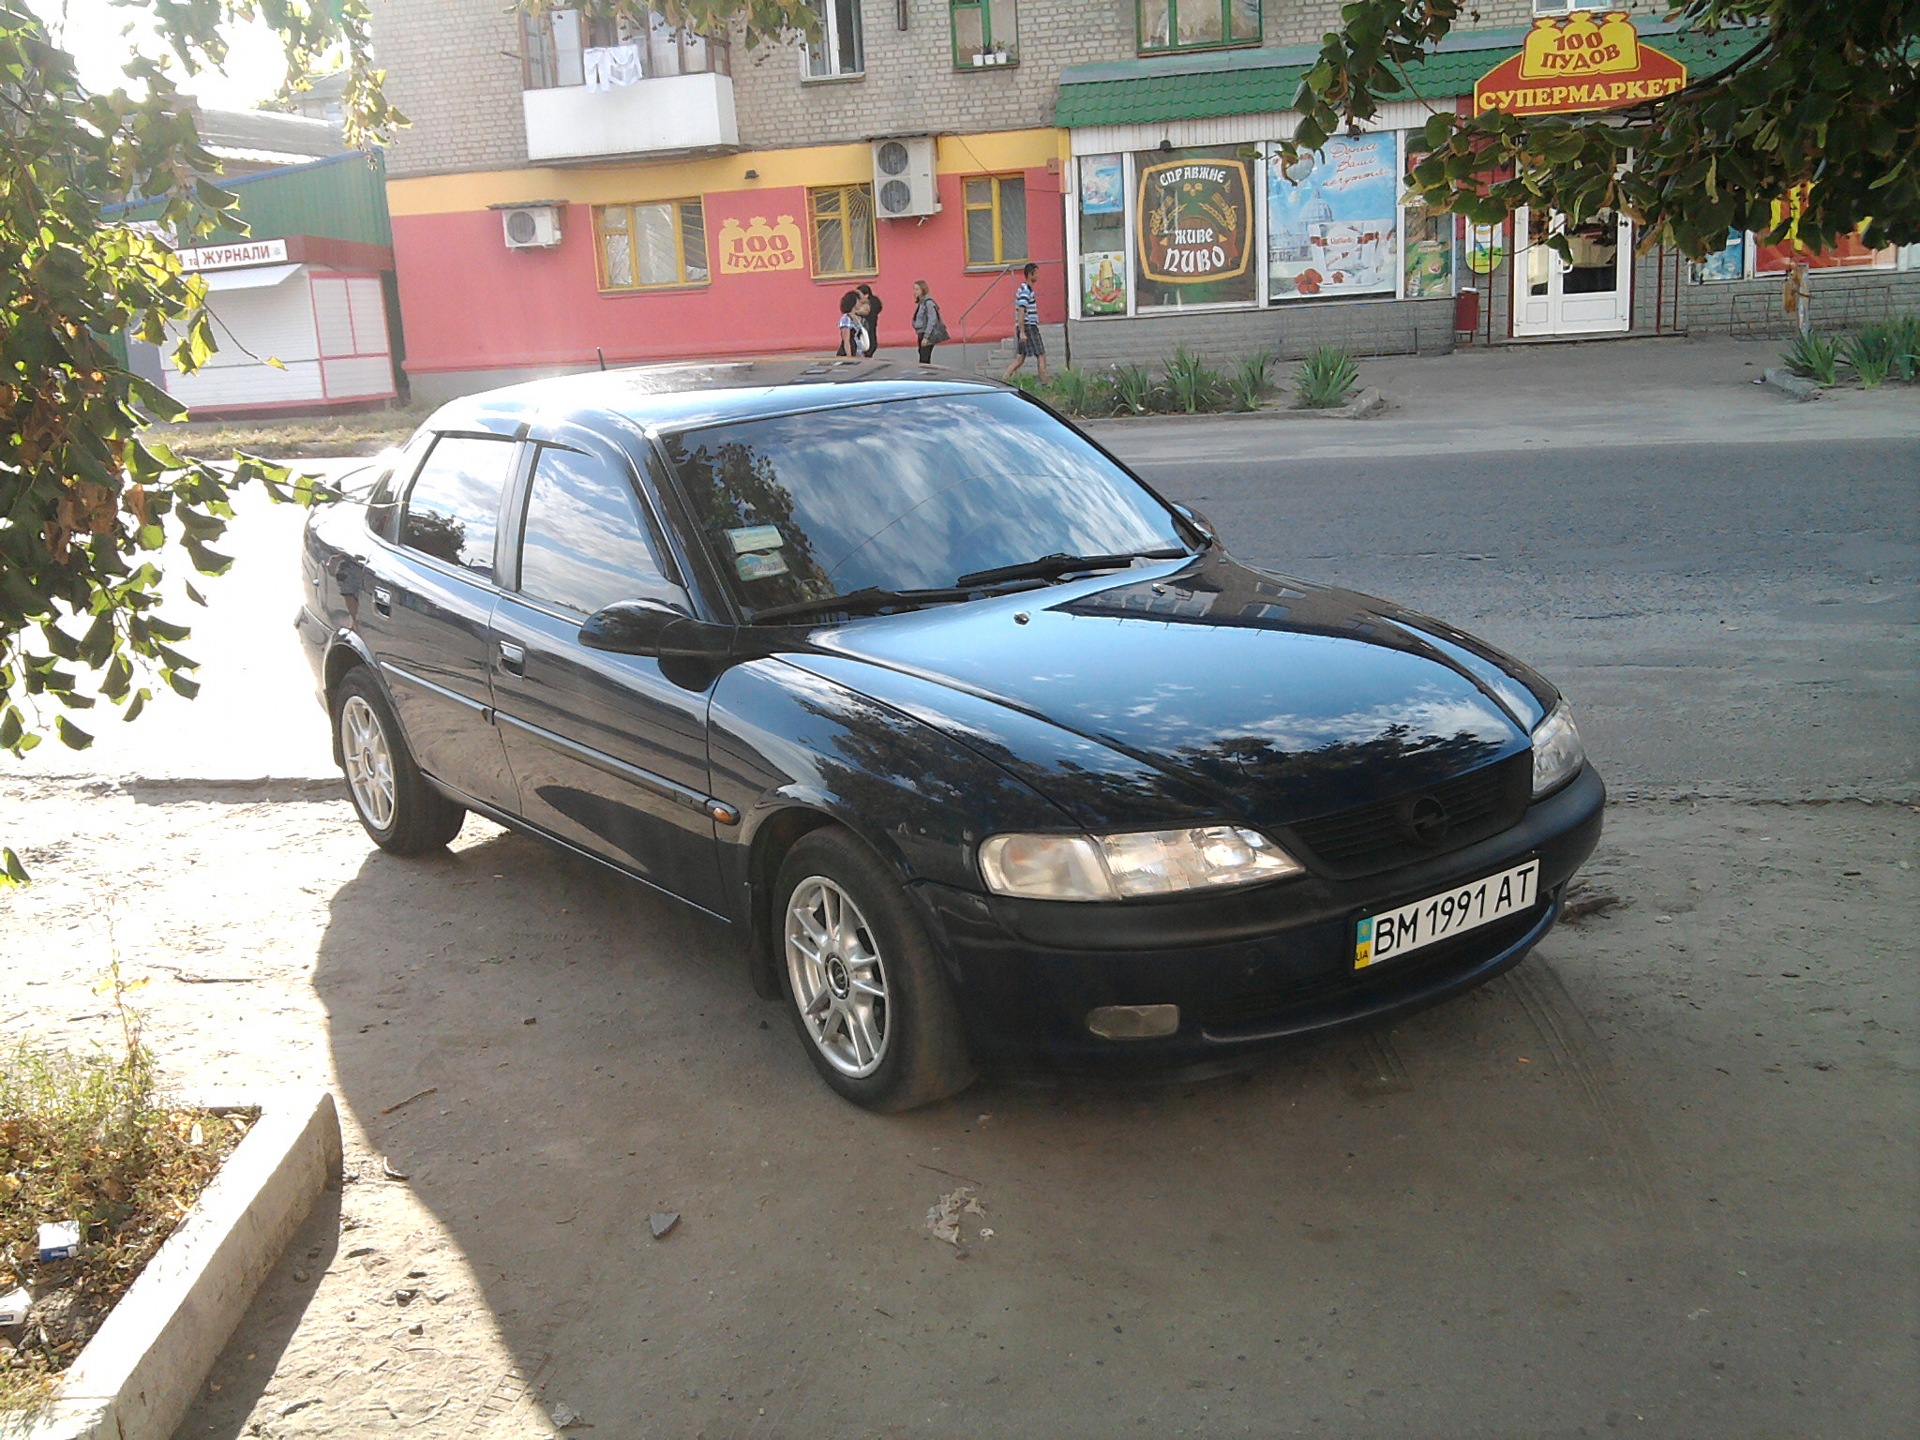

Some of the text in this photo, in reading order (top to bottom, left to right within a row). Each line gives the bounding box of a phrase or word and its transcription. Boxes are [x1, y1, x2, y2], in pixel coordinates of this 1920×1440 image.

[1553, 32, 1603, 51] 100
[1540, 44, 1621, 71] ПУДОВ
[1479, 77, 1681, 110] СУПЕРМАРКЕТ
[730, 234, 789, 254] 100
[202, 245, 270, 265] ЖУРНАЛИ
[727, 249, 796, 270] ПУДОВ
[1374, 865, 1535, 956] BM 1991 AT
